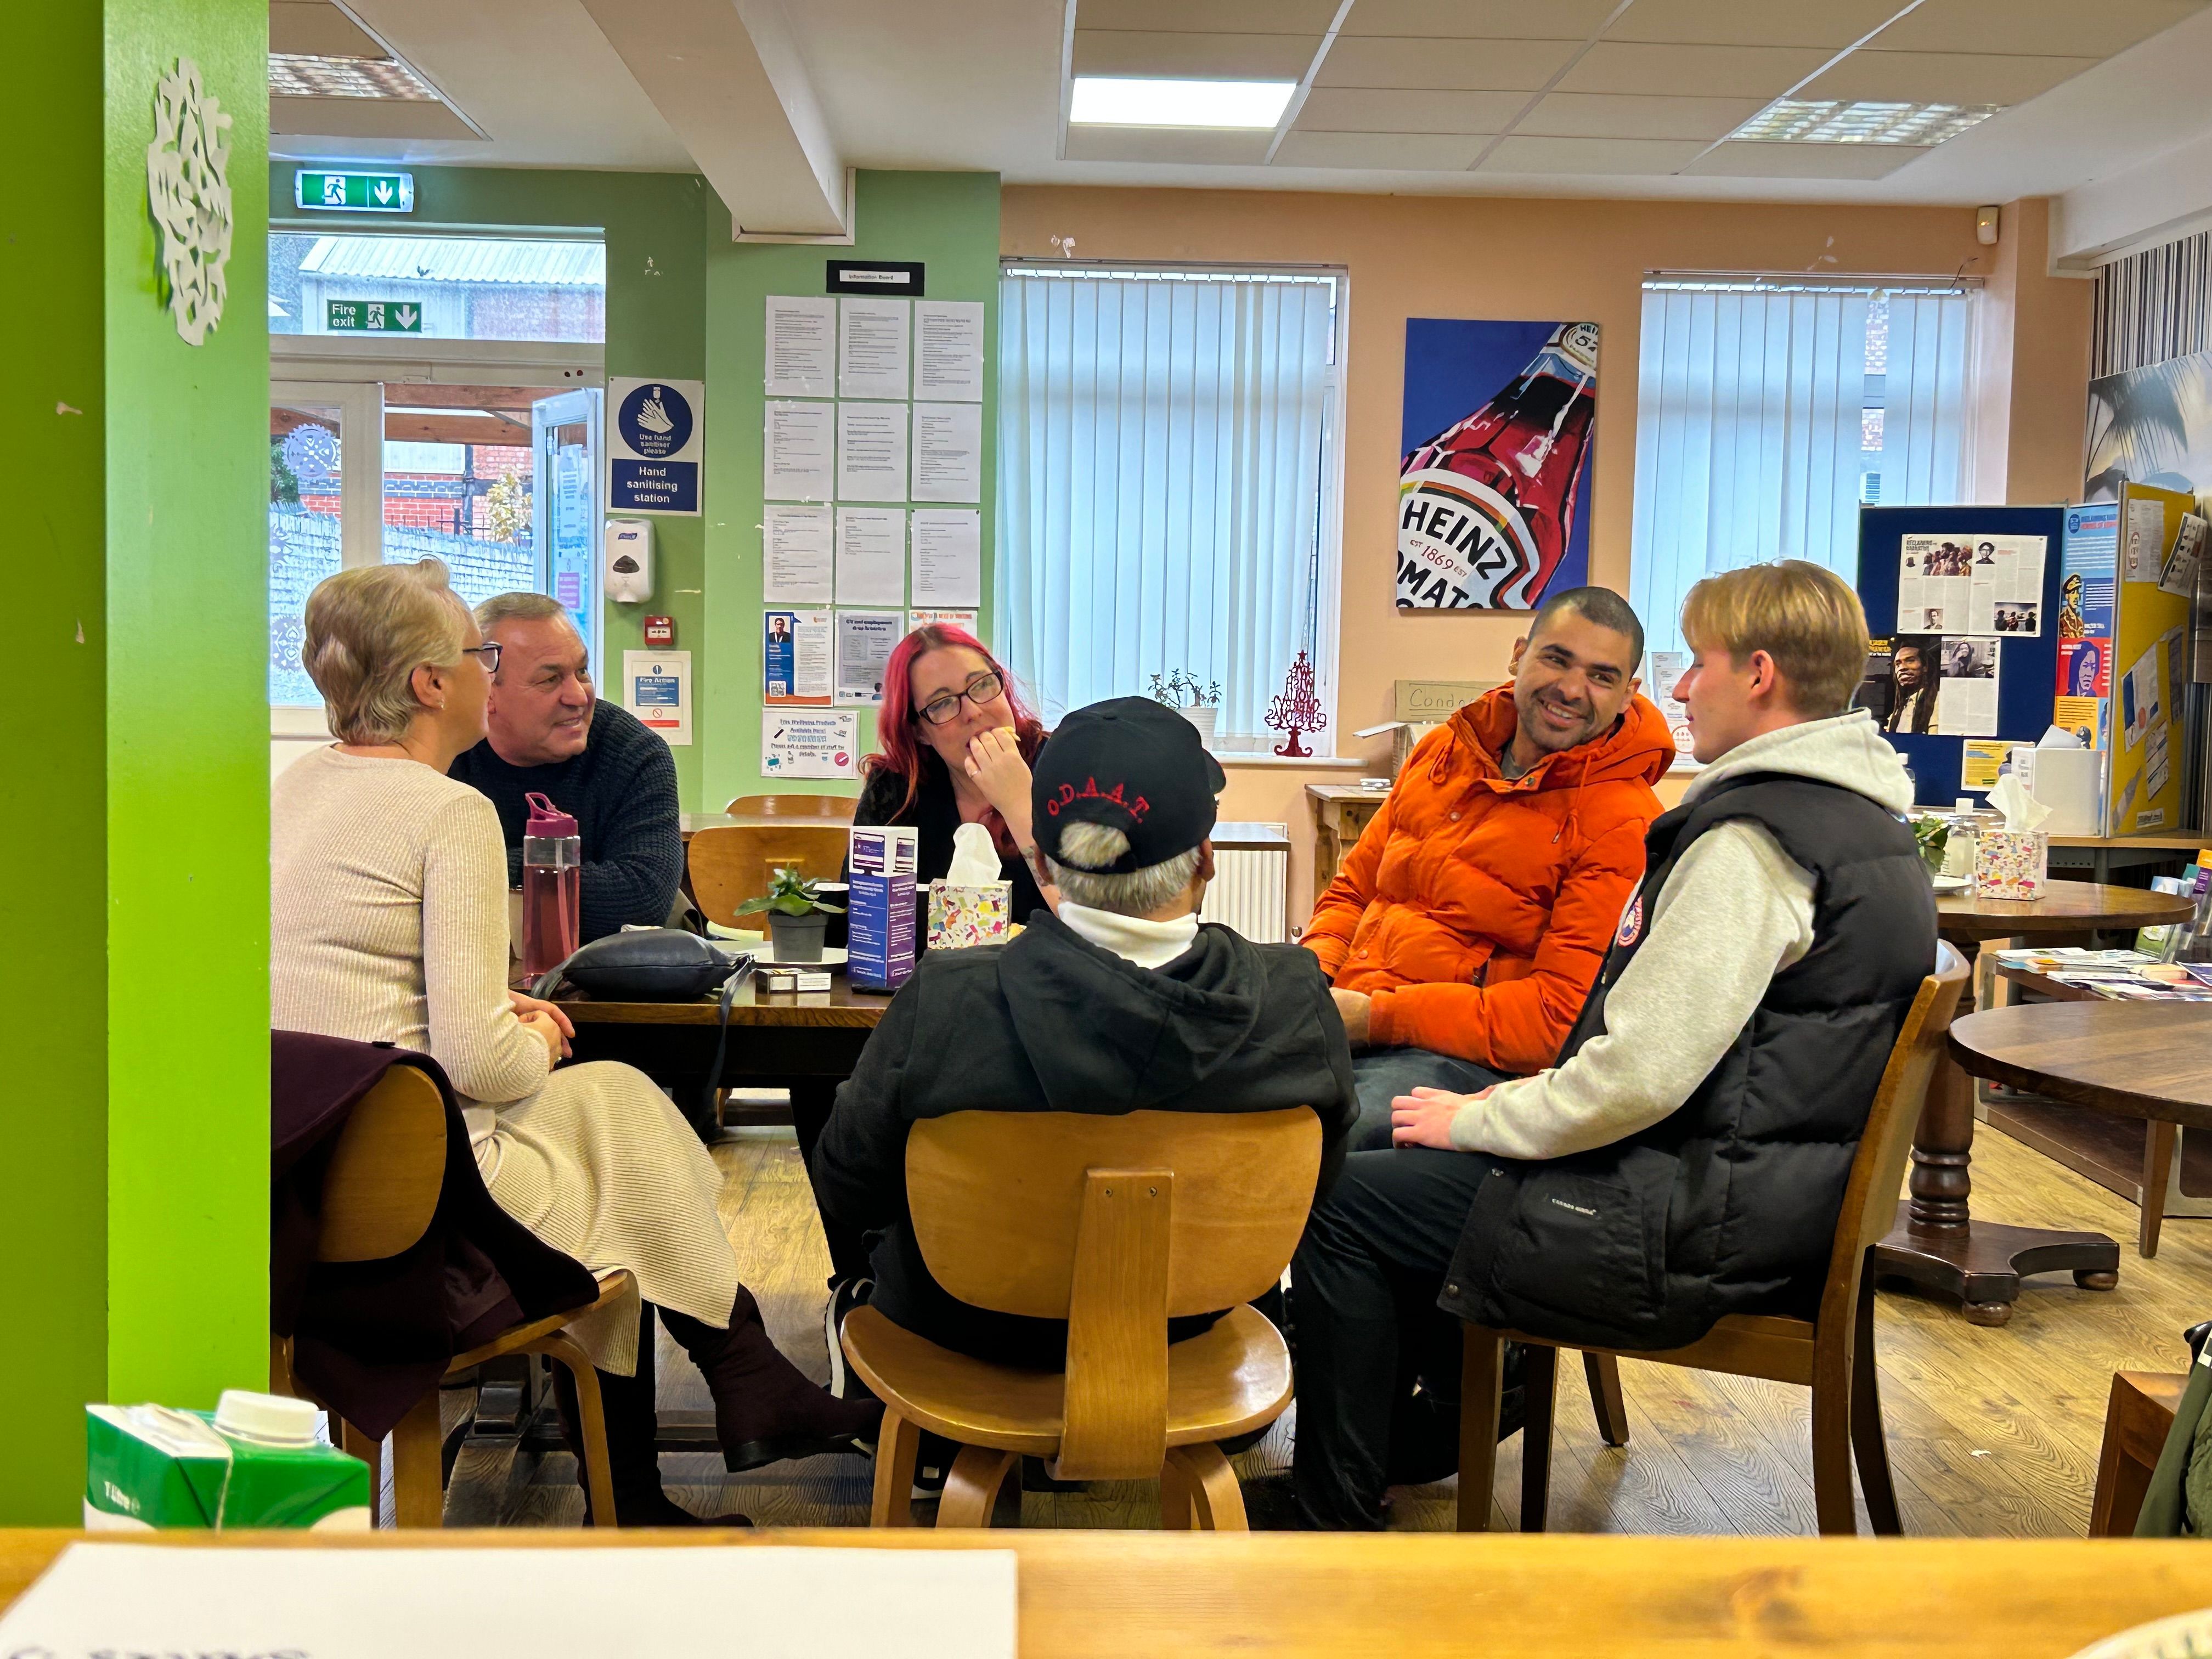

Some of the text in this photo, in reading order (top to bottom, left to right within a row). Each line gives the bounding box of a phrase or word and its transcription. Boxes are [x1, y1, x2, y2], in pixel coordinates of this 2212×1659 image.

[332, 304, 356, 315] Fire
[332, 316, 356, 327] exit
[639, 466, 666, 476] Hand
[627, 479, 678, 492] sanitising
[634, 494, 670, 503] station
[1401, 499, 1506, 580] HEINZ
[1421, 545, 1454, 569] 1869
[1397, 550, 1483, 608] MAT
